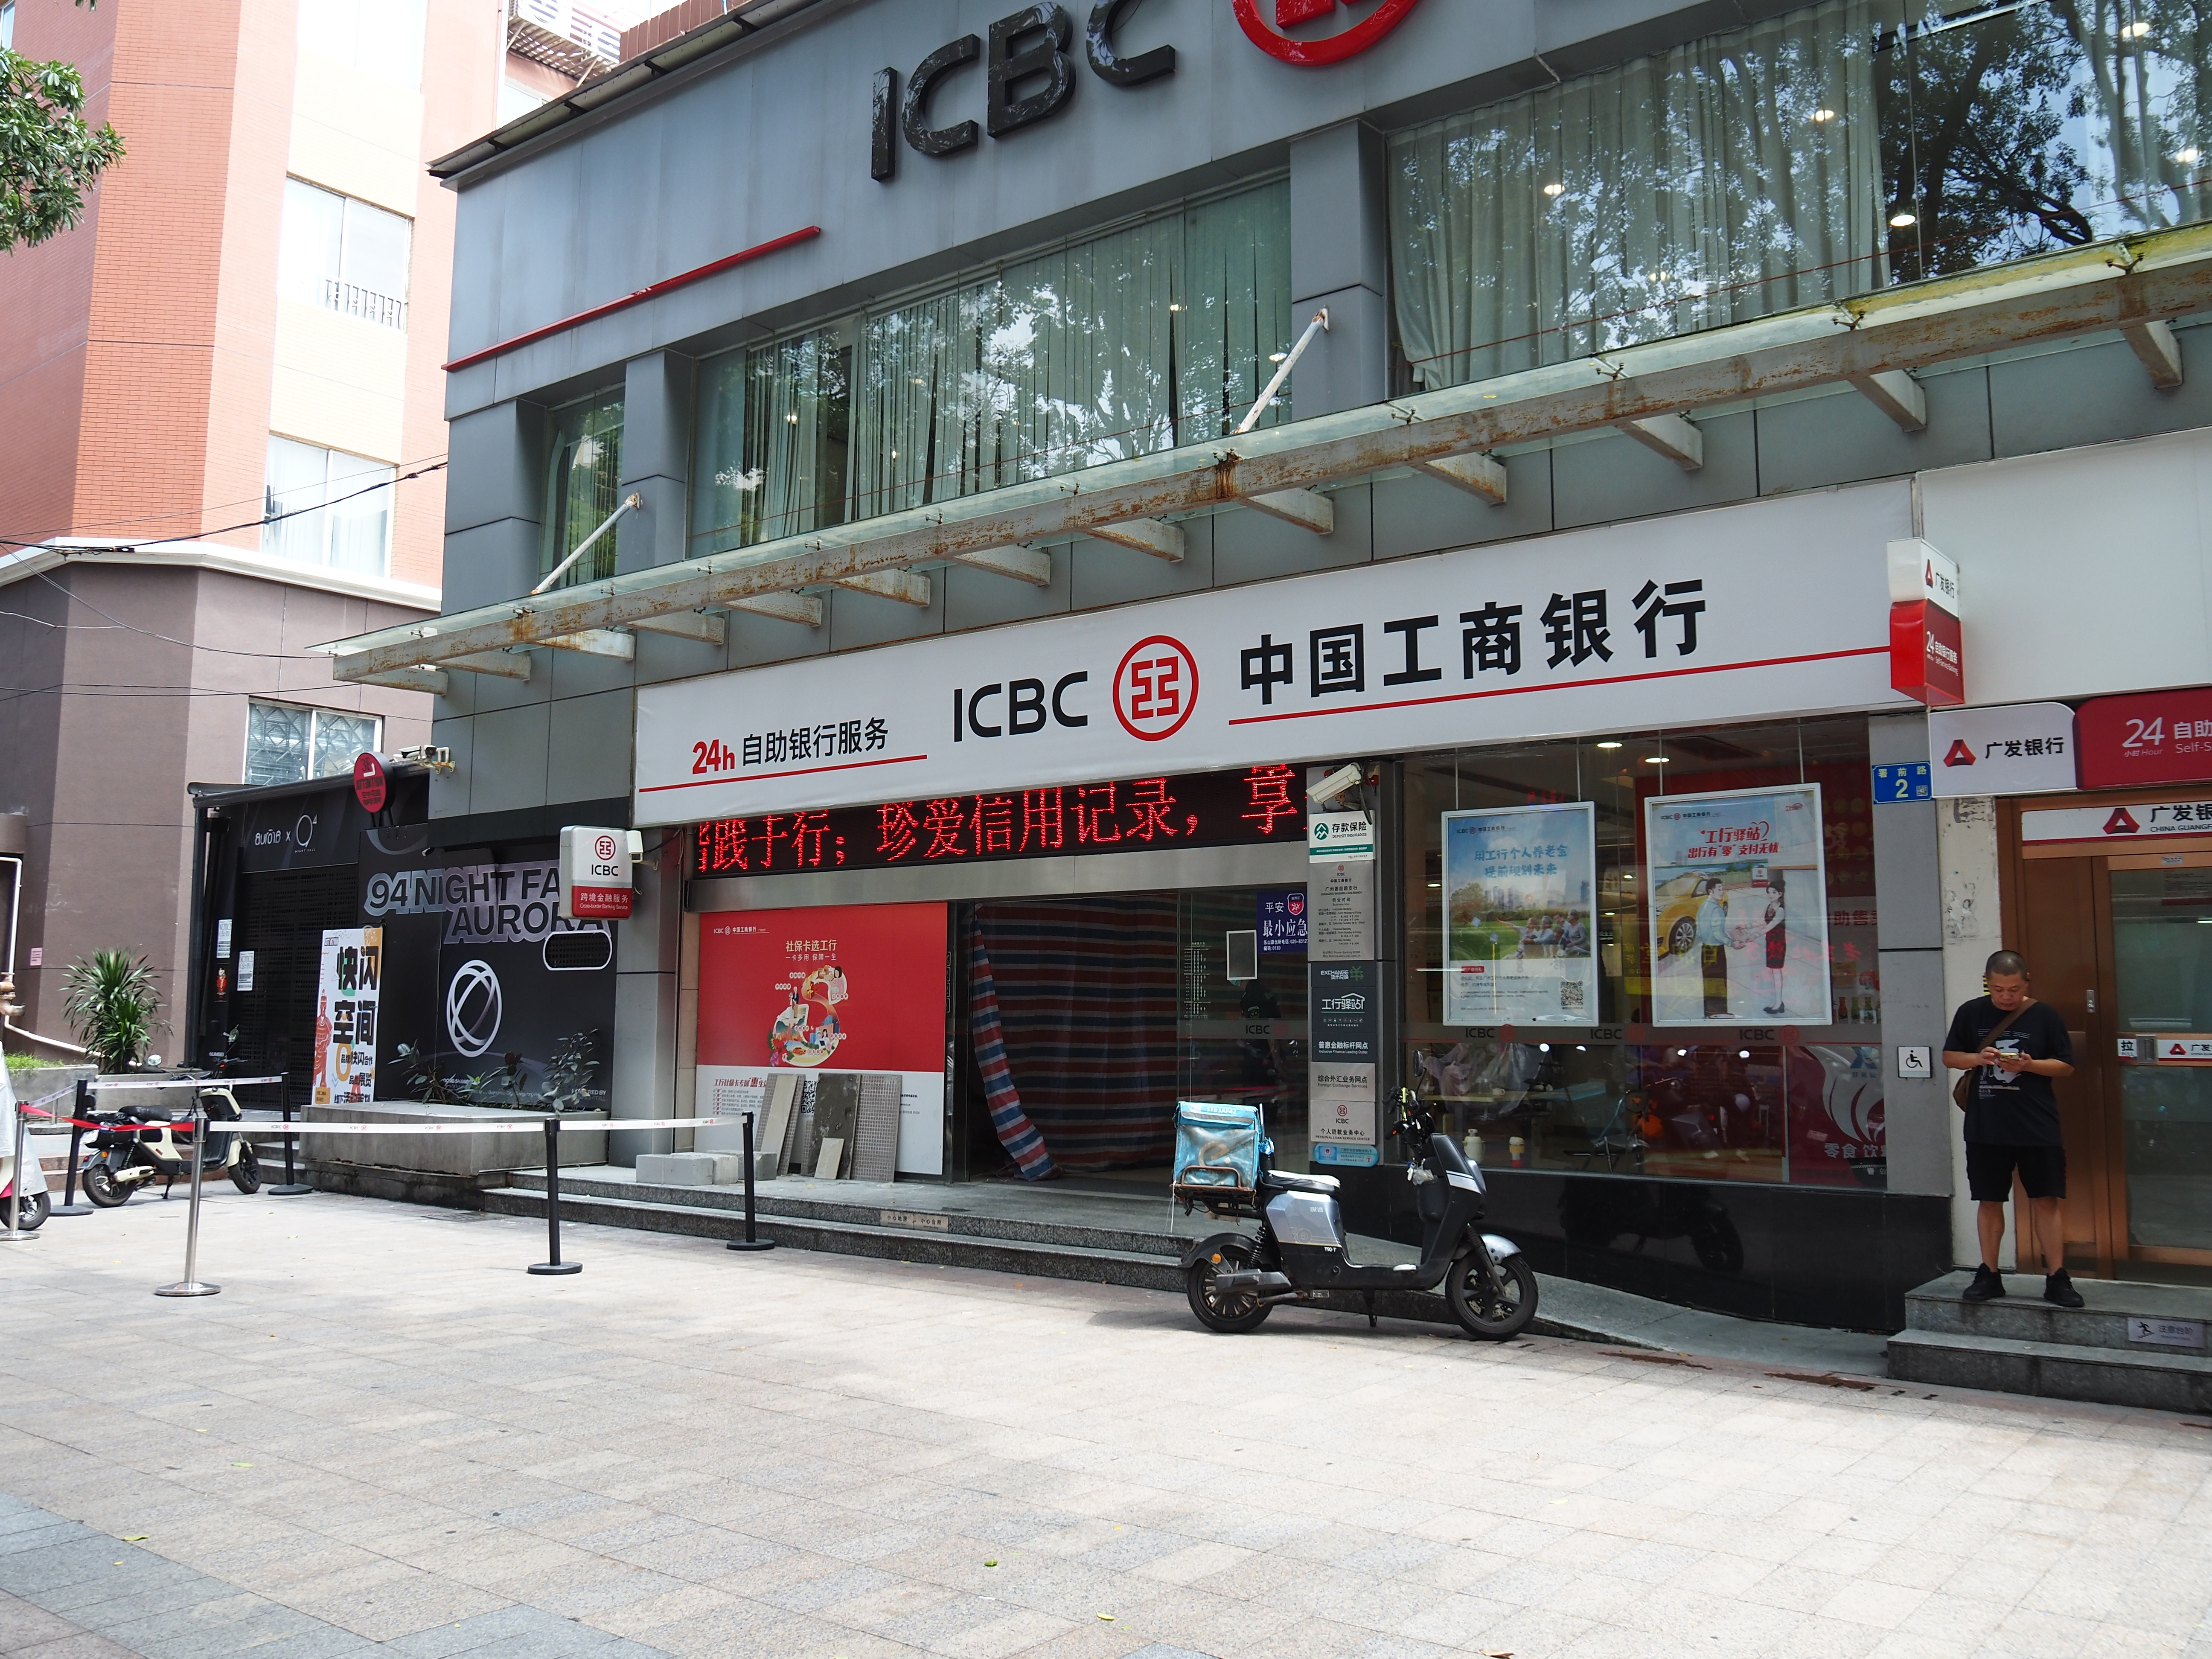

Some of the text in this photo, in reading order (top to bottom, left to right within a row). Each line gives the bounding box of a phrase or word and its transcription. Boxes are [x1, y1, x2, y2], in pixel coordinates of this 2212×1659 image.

[871, 0, 1176, 182] ICBC
[1240, 579, 1706, 705] 中国工商银行
[1927, 631, 1935, 654] 24
[954, 670, 1088, 742] ICBC
[2122, 717, 2165, 748] 24
[693, 717, 889, 774] 24h 自助银行服务
[1985, 737, 2064, 759] 广发银行
[1878, 765, 1927, 778] 署前路
[1895, 779, 1909, 798] 2
[1332, 821, 1367, 833] 存款保险
[1705, 827, 1761, 844] 工行驿站
[1474, 844, 1568, 861] 用工行个人养老金
[591, 864, 619, 876] ICBC
[1485, 863, 1557, 878] 提前规划未来
[371, 867, 560, 909] 94 NIGHT FA
[580, 892, 629, 903] 跨境金融服务
[1265, 901, 1284, 913] 平安
[1263, 918, 1308, 937] 最小应急
[786, 939, 837, 952] 社保卡选工行
[812, 953, 837, 961] 保障一生
[336, 946, 379, 990] 快闪
[1321, 996, 1365, 1010] 工行驿站
[333, 999, 376, 1046] 空间
[1246, 1025, 1270, 1034] ICBC
[1465, 1028, 1495, 1038] ICBC
[1590, 1028, 1623, 1040] ICBC
[1740, 1029, 1775, 1041] ICBC
[1318, 1041, 1368, 1050] 普惠金融标杆网点
[2121, 1040, 2134, 1051] 拉
[1318, 1075, 1368, 1083] 综合外汇业务网点
[1321, 1128, 1365, 1136] 个人贷款业务中心
[1825, 1143, 1857, 1158] 零食
[920, 1217, 942, 1225] 小心台阶
[2158, 1324, 2194, 1335] 注意台阶
